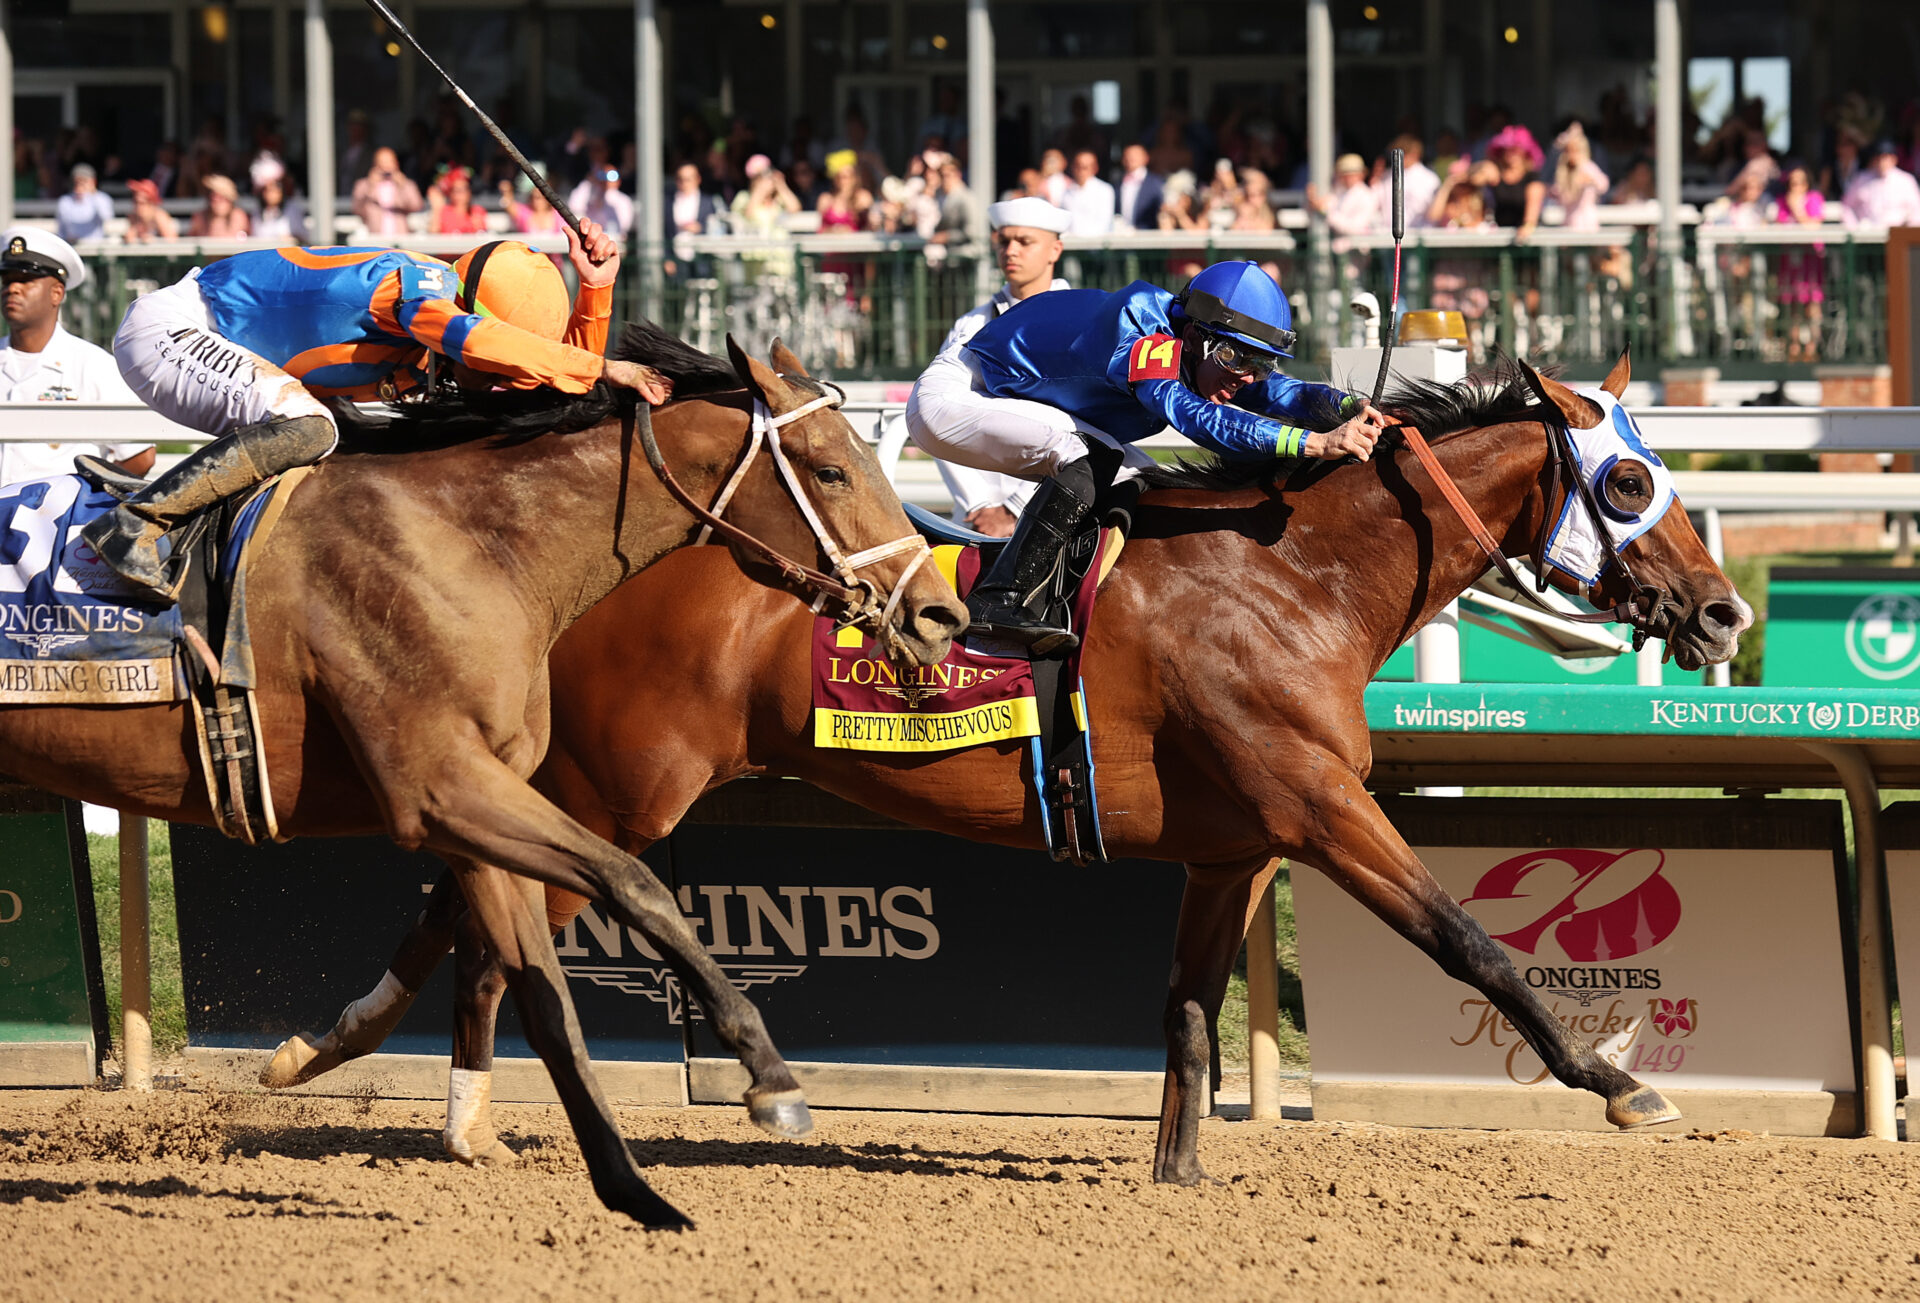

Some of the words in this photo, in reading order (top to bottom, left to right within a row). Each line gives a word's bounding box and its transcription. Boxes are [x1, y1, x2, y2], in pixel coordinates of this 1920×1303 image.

[1136, 339, 1176, 370] 14
[0, 474, 82, 593] 3
[96, 664, 159, 692] GIRL
[832, 714, 896, 742] PRETTY
[900, 705, 1012, 743] MISCHIEVOUS
[1394, 692, 1527, 731] twinspires
[1650, 700, 1805, 729] KENTUCKY
[1518, 966, 1662, 990] ONGINES
[1629, 1043, 1687, 1073] 149
